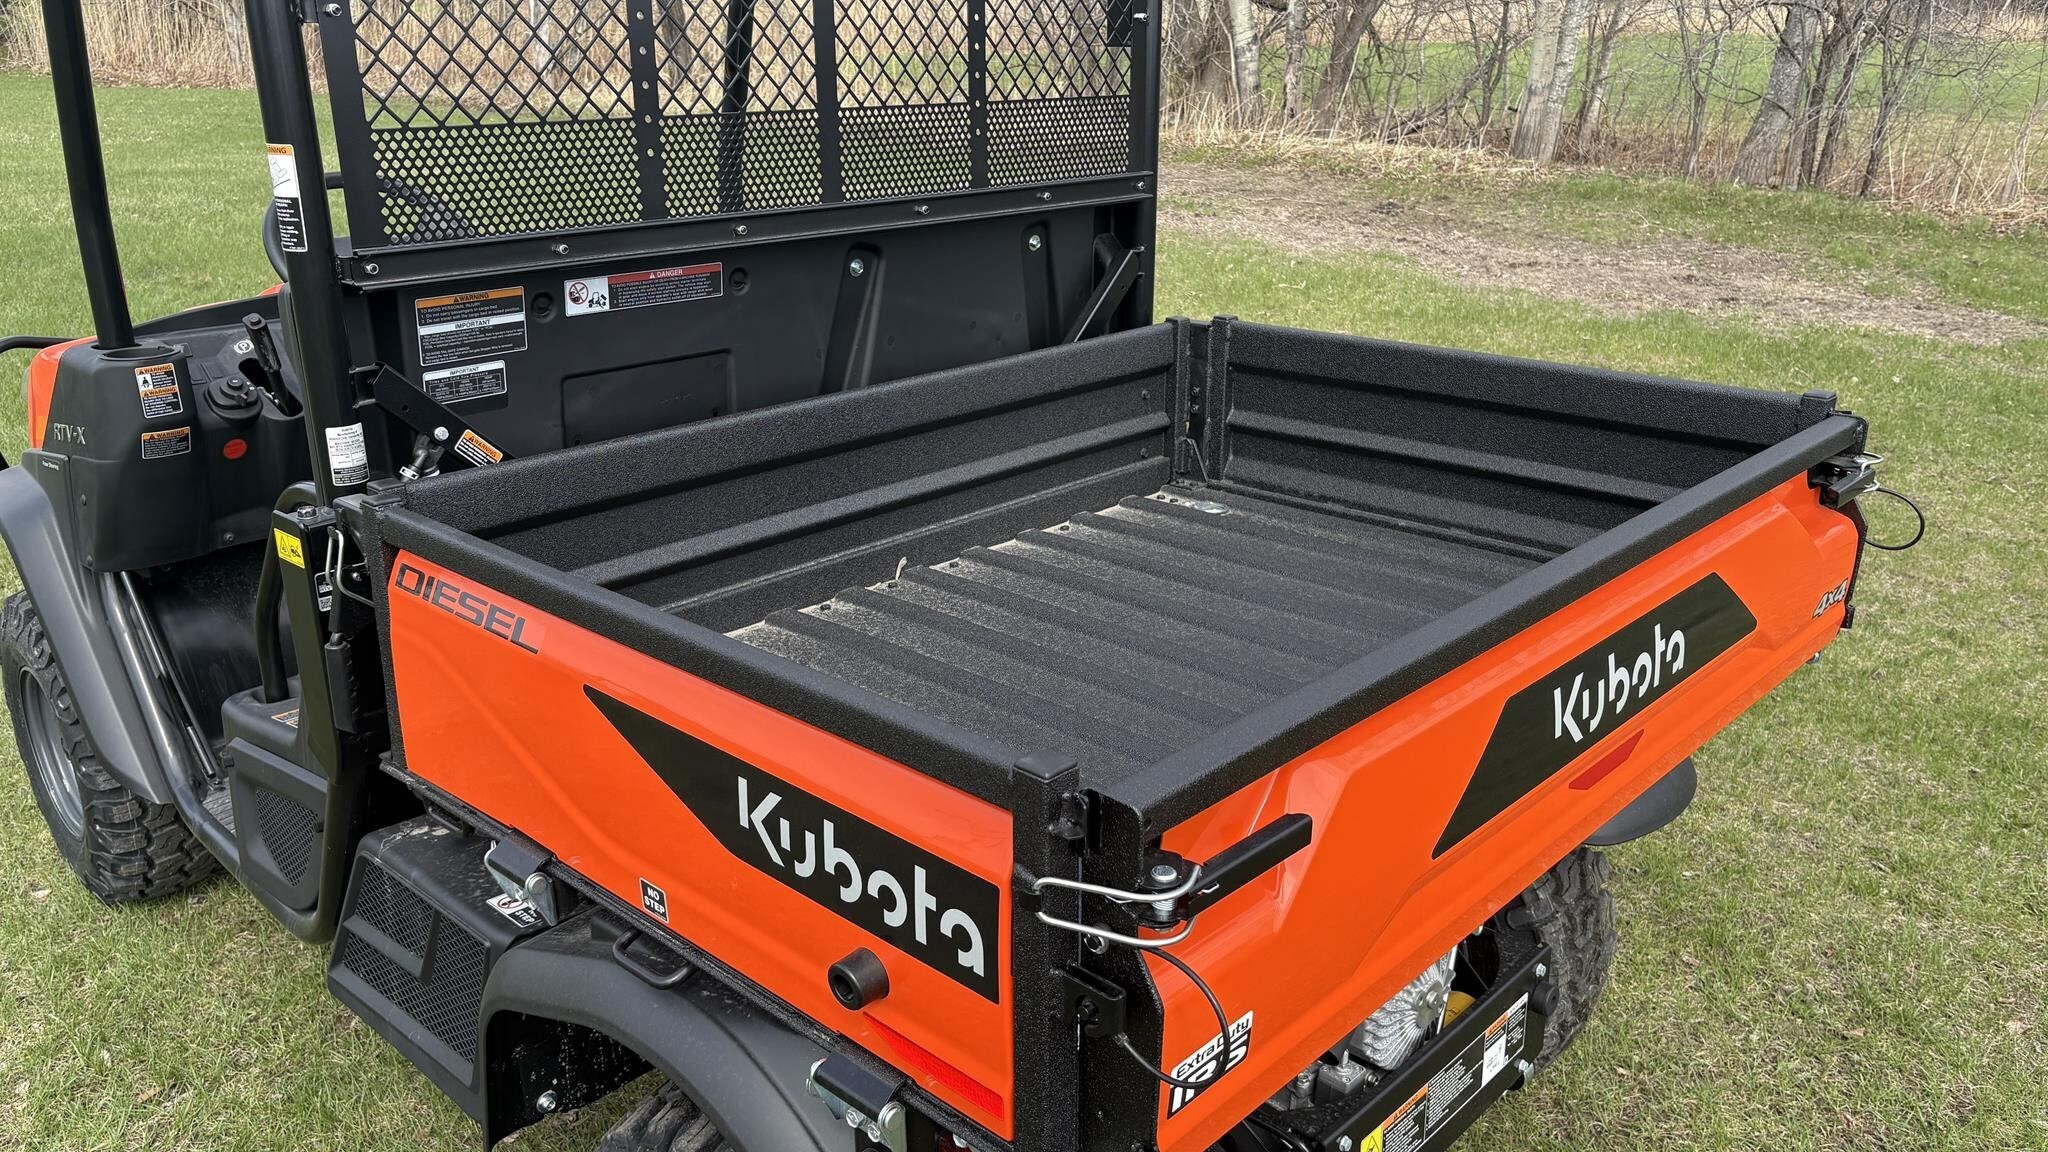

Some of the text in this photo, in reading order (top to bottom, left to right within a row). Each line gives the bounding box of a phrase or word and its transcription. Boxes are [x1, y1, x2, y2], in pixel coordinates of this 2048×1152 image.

[656, 269, 682, 278] DANGER
[460, 292, 489, 302] WARNING
[454, 320, 490, 329] IMPORTANT
[144, 364, 172, 374] WARNING
[450, 366, 479, 376] IMPORTANT
[148, 387, 176, 396] WARNING
[54, 422, 86, 445] RTV-X
[156, 430, 185, 438] WARNING
[474, 438, 496, 458] WARNING
[1812, 577, 1848, 618] 4x4
[395, 562, 539, 654] DIESEL
[1554, 623, 1685, 743] Kubota
[738, 776, 984, 977] Kubota
[647, 886, 660, 900] NO
[644, 896, 665, 914] STEP
[514, 910, 535, 922] STEP
[1176, 1044, 1215, 1079] Extra
